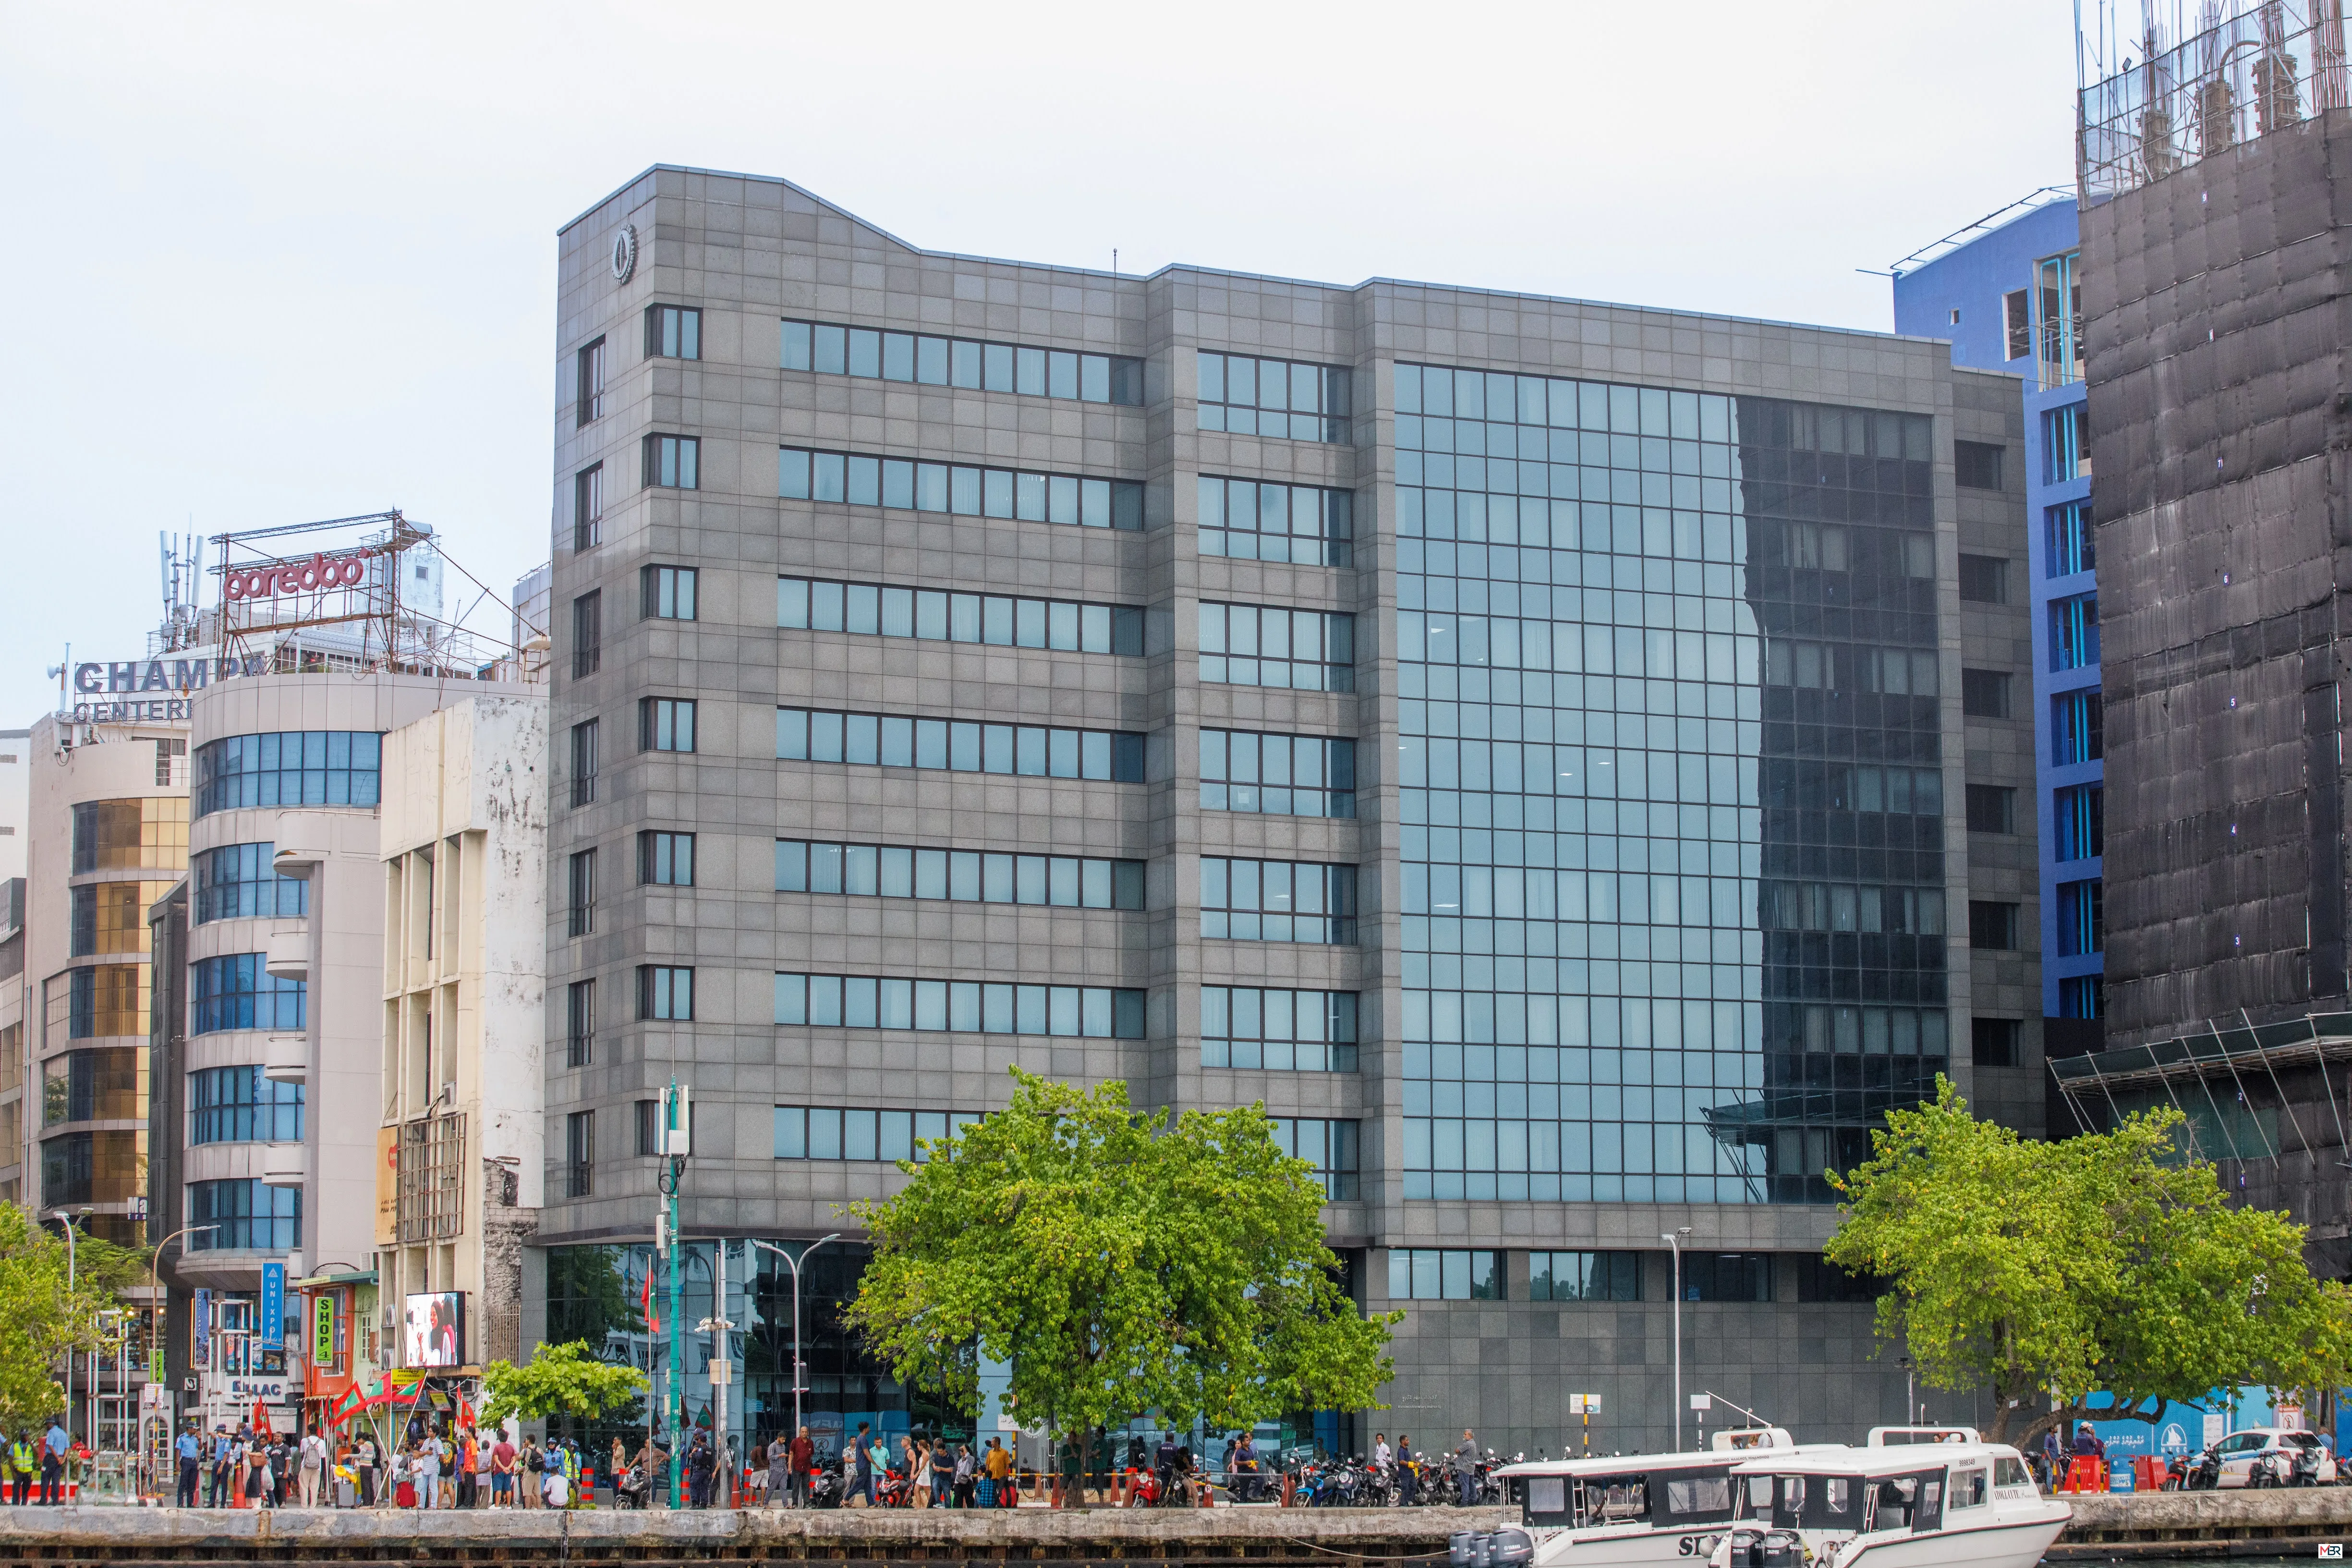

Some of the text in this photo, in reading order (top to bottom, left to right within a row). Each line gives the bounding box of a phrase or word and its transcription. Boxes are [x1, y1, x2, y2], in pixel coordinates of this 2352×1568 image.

[2202, 194, 2207, 202] 9
[2218, 459, 2221, 467] 7
[224, 552, 364, 600] ooredoo
[2224, 575, 2228, 583] 6
[75, 656, 267, 693] CHAMPA
[2231, 698, 2235, 706] 5
[73, 698, 192, 723] CENTER
[2231, 826, 2236, 834] 4
[2235, 937, 2239, 945] 3
[2238, 1092, 2243, 1100] 2
[319, 1299, 329, 1347] SHOP
[1959, 1458, 1975, 1467] 9998349
